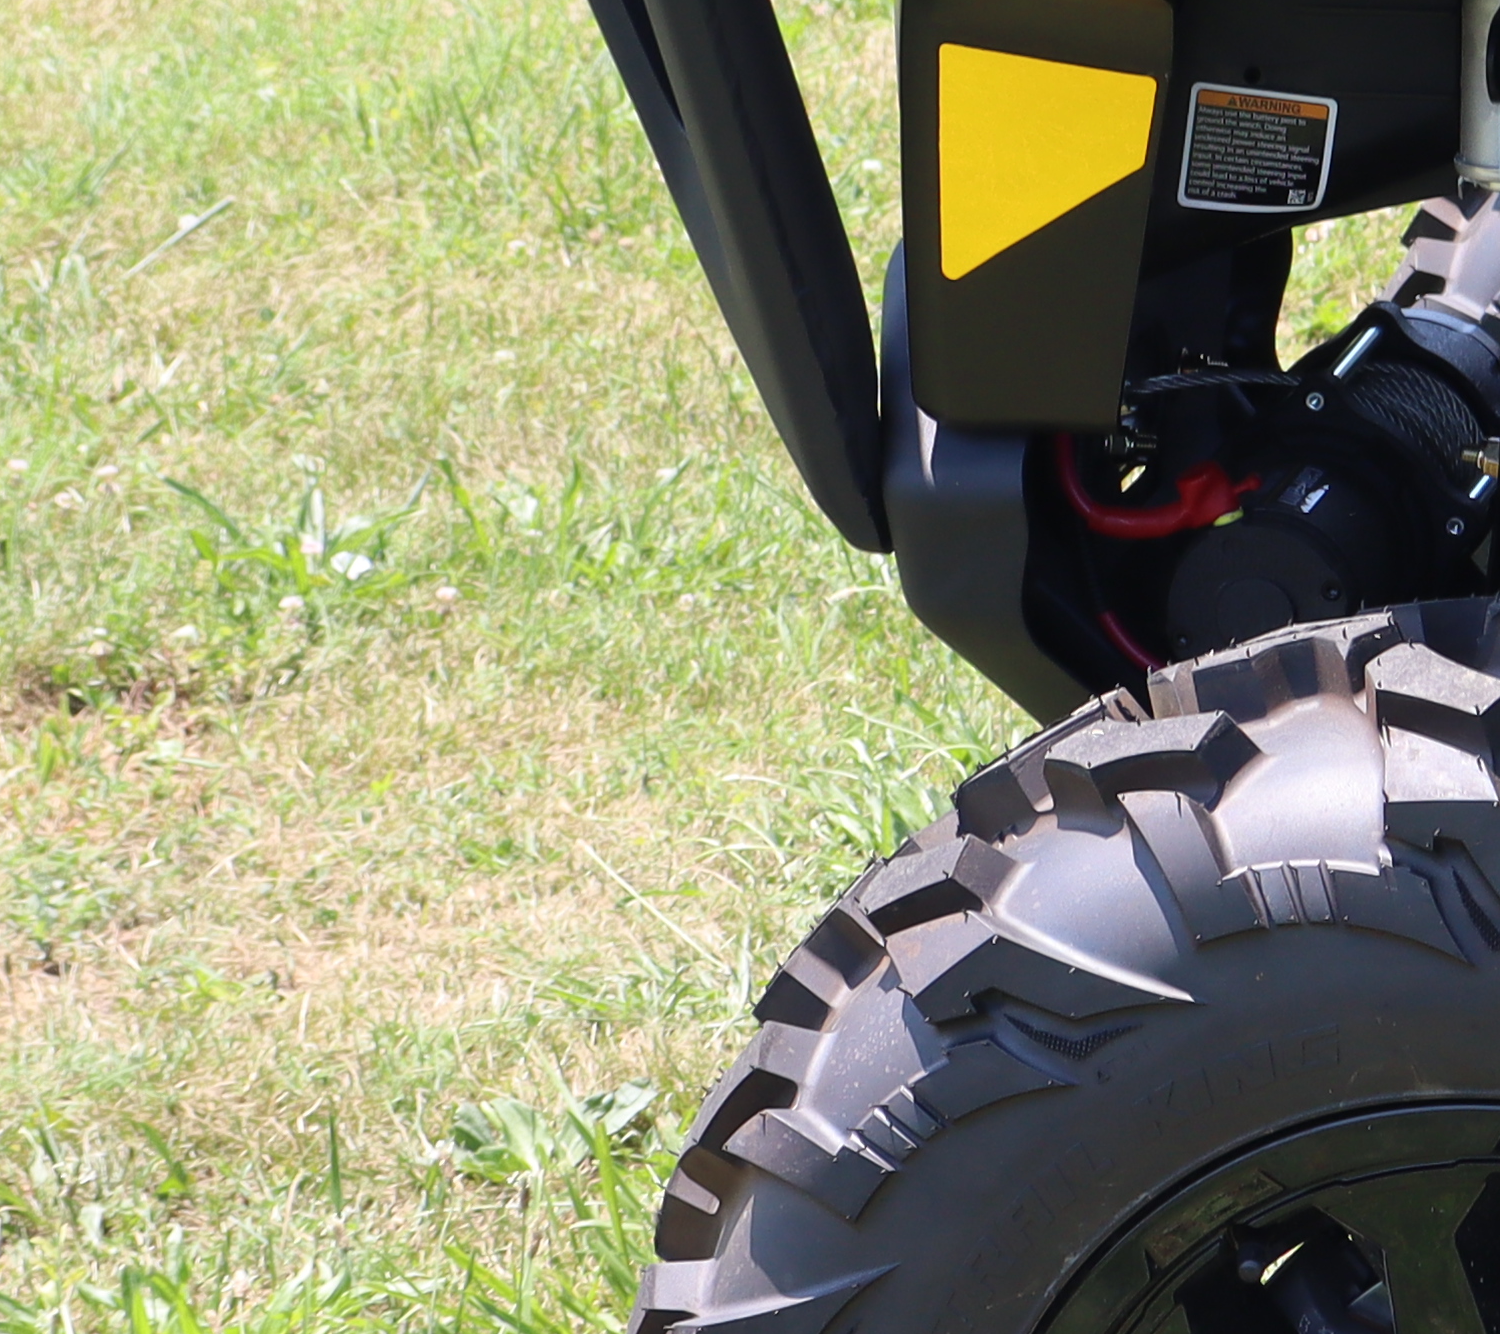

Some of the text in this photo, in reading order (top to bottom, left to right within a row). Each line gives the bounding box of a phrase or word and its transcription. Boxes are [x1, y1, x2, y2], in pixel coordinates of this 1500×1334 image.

[1239, 96, 1301, 114] WARNING
[1198, 105, 1306, 126] Always use the battery post to
[1195, 125, 1286, 142] otherwise may induce an
[1197, 117, 1223, 125] ground
[1264, 123, 1287, 134] Doing
[1194, 134, 1310, 154] undesired power steering signal
[1193, 143, 1225, 153] resulting
[1246, 149, 1289, 160] unintended
[1290, 154, 1319, 165] steering
[1223, 156, 1249, 164] certain
[1190, 169, 1210, 177] could
[1212, 171, 1227, 179] lead
[1243, 174, 1258, 184] loss
[1269, 178, 1294, 187] vehicle
[1212, 163, 1255, 174] unintended
[1257, 167, 1286, 178] steering
[1287, 171, 1306, 180] input
[1187, 186, 1200, 194] risk
[1201, 187, 1210, 195] of
[1189, 179, 1215, 187] control
[1216, 181, 1253, 192] increasing
